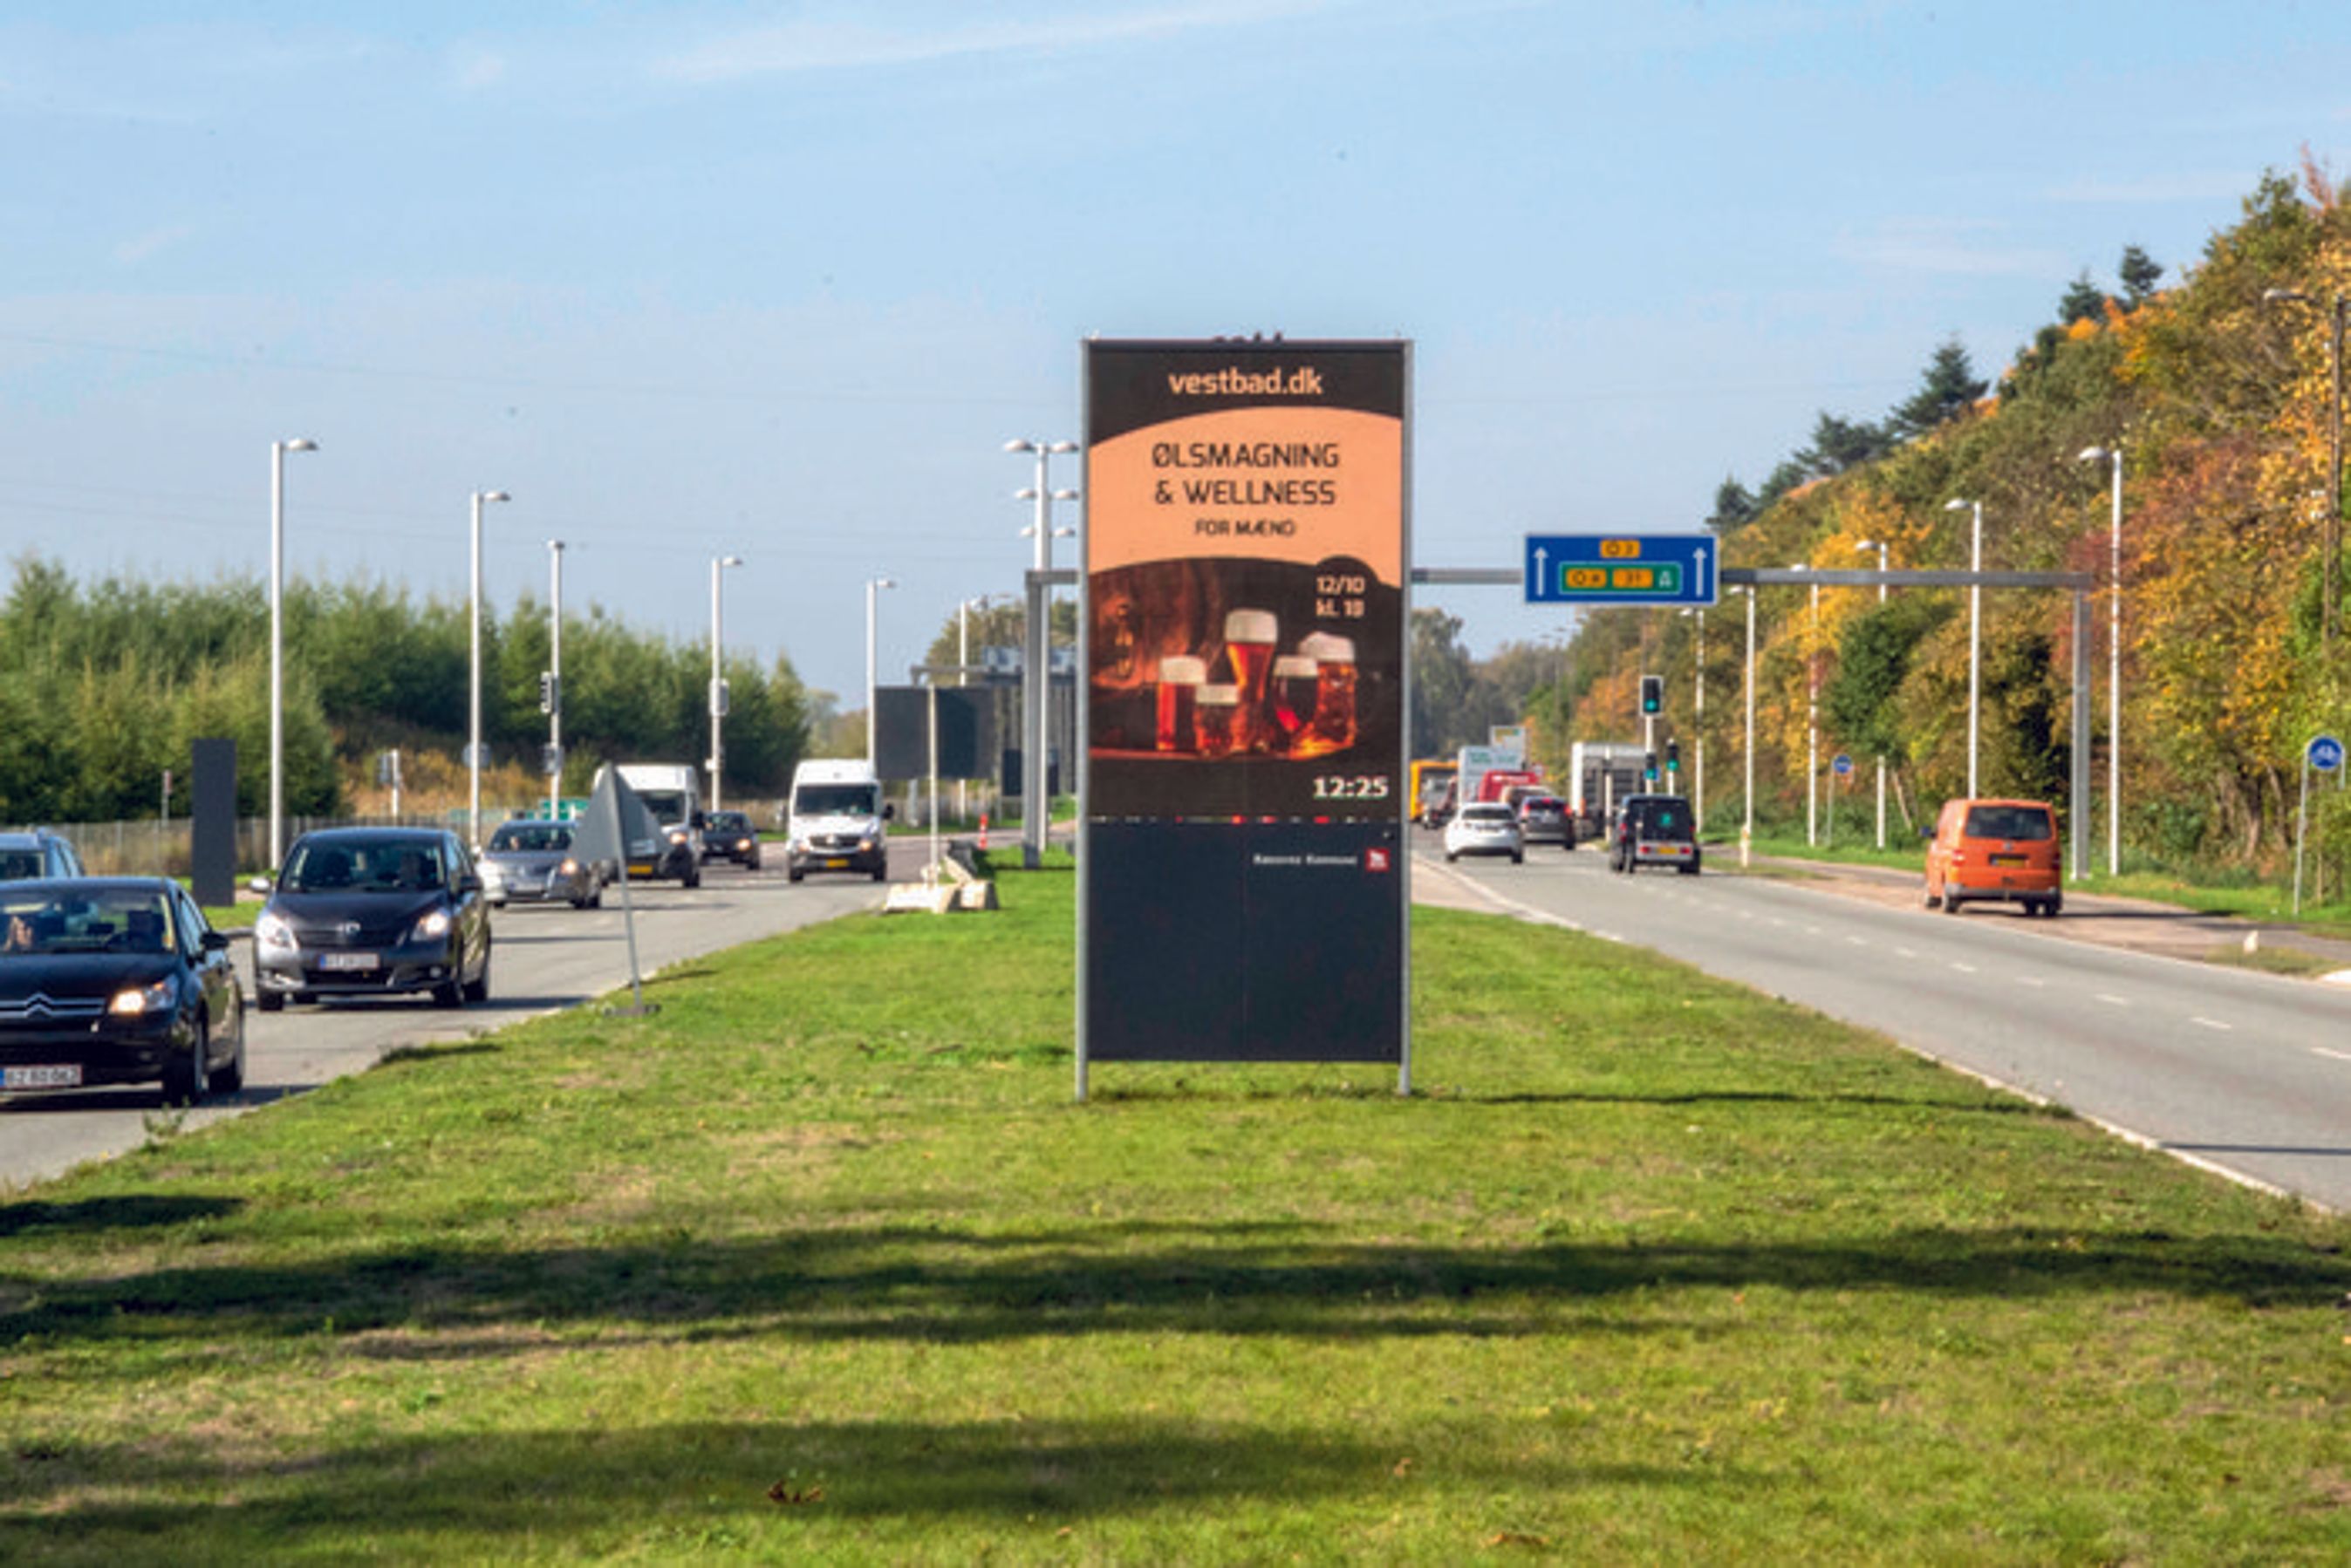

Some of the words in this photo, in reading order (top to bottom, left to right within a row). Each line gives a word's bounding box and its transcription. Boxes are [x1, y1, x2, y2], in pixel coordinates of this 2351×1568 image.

[1168, 366, 1322, 394] vestbad.dk
[1152, 442, 1340, 468] ØLSMAGNING
[1154, 480, 1175, 506] &
[1182, 479, 1336, 506] WELLNESS
[1194, 519, 1230, 537] FOR
[1316, 575, 1365, 595] 12/10
[1313, 776, 1389, 798] 12:25
